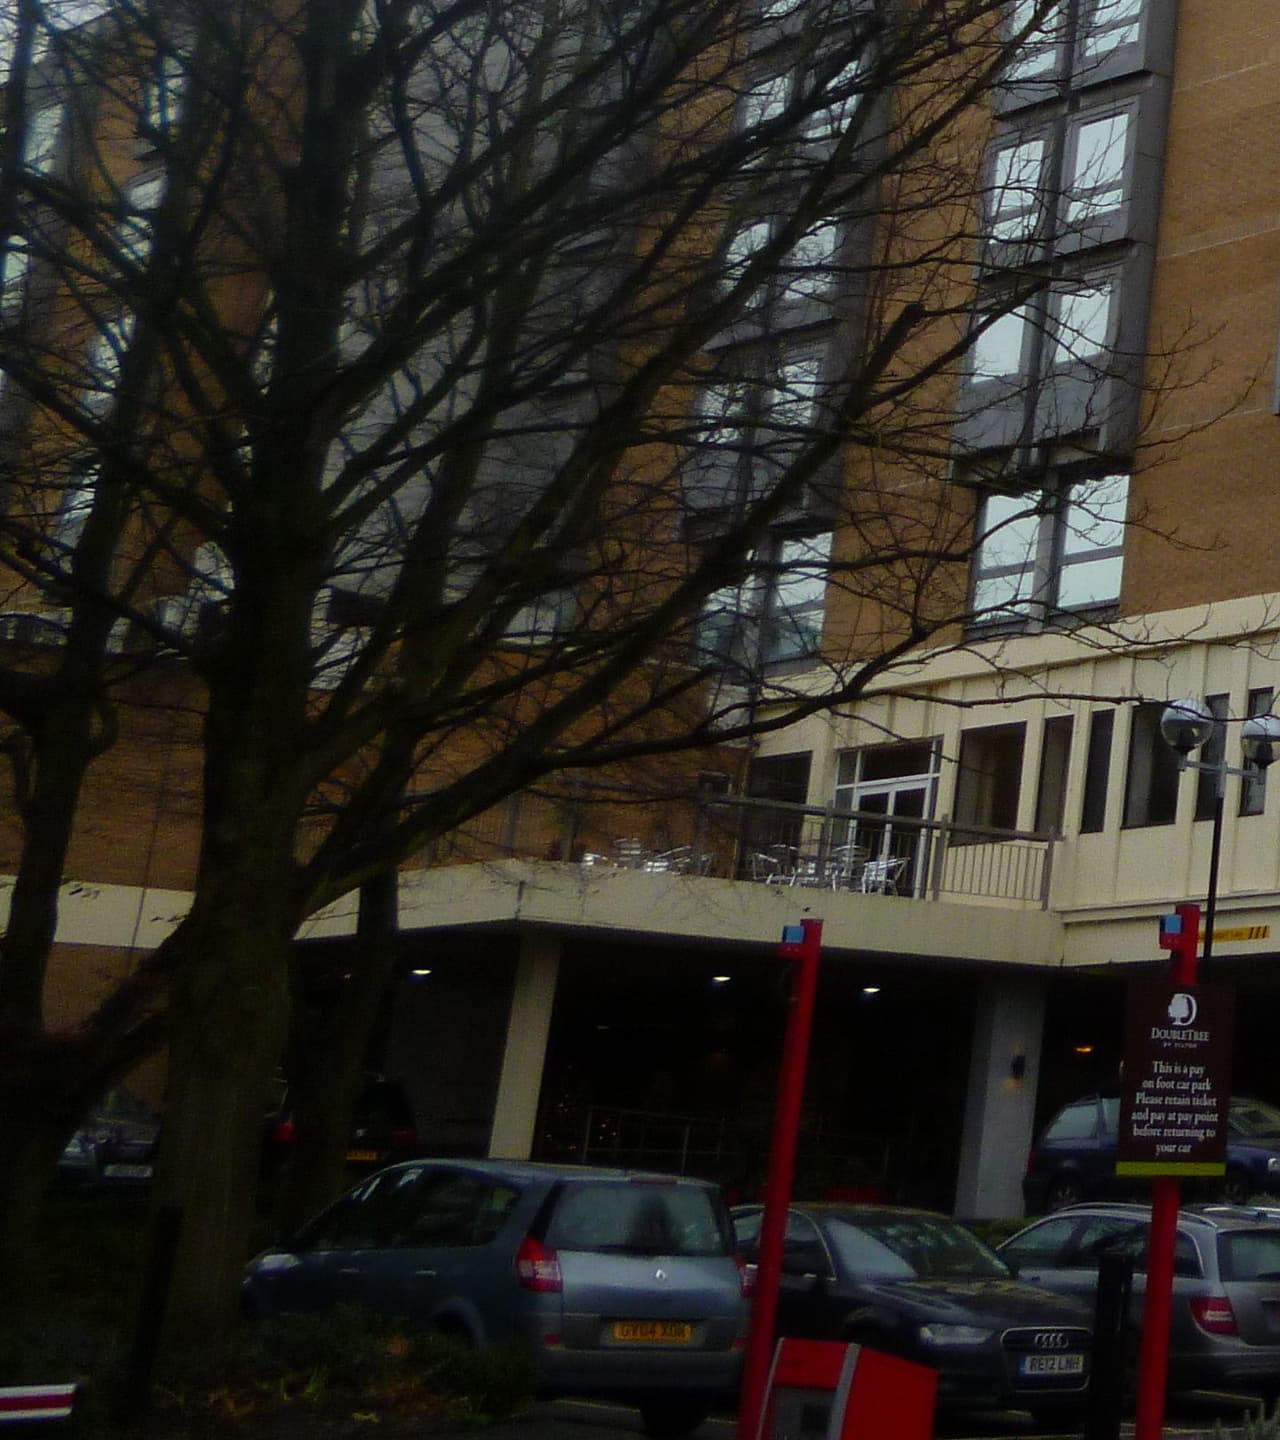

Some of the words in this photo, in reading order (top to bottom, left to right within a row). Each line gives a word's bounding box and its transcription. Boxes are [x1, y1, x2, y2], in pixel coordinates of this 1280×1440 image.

[1152, 1060, 1173, 1073] This
[1174, 1061, 1182, 1073] is
[1189, 1065, 1205, 1078] pay
[1142, 1079, 1155, 1089] on
[1156, 1076, 1175, 1089] foot
[1176, 1080, 1190, 1089] car
[1191, 1077, 1212, 1094] park
[1136, 1091, 1163, 1104] Please
[1165, 1093, 1191, 1105] retain
[1192, 1093, 1217, 1106] ticket
[1131, 1107, 1149, 1121] and
[1150, 1112, 1166, 1124] pay
[1167, 1112, 1177, 1121] at
[1177, 1112, 1193, 1125] pay
[1194, 1110, 1219, 1125] point
[1133, 1123, 1162, 1137] before
[1163, 1126, 1205, 1142] returning
[1206, 1128, 1216, 1138] to
[1155, 1144, 1177, 1157] your
[1177, 1144, 1192, 1153] car
